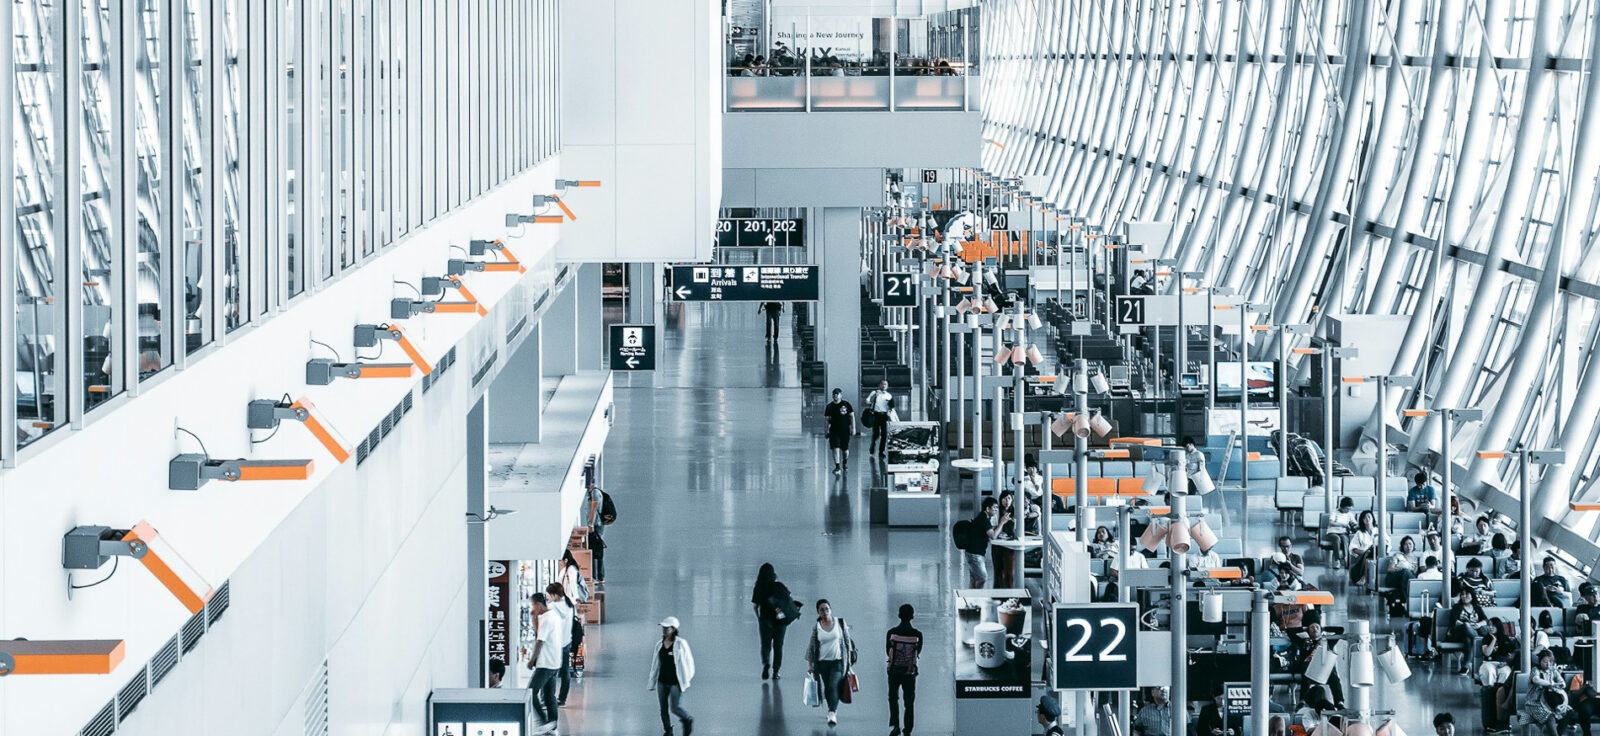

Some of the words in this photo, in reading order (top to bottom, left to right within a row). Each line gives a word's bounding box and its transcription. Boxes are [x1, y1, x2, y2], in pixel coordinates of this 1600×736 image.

[777, 32, 807, 40] Shaing
[835, 32, 864, 40] Journey
[925, 171, 936, 182] 19
[992, 213, 1006, 228] 20
[887, 277, 911, 297] 21
[1123, 300, 1141, 323] 21
[1065, 618, 1127, 662] 22
